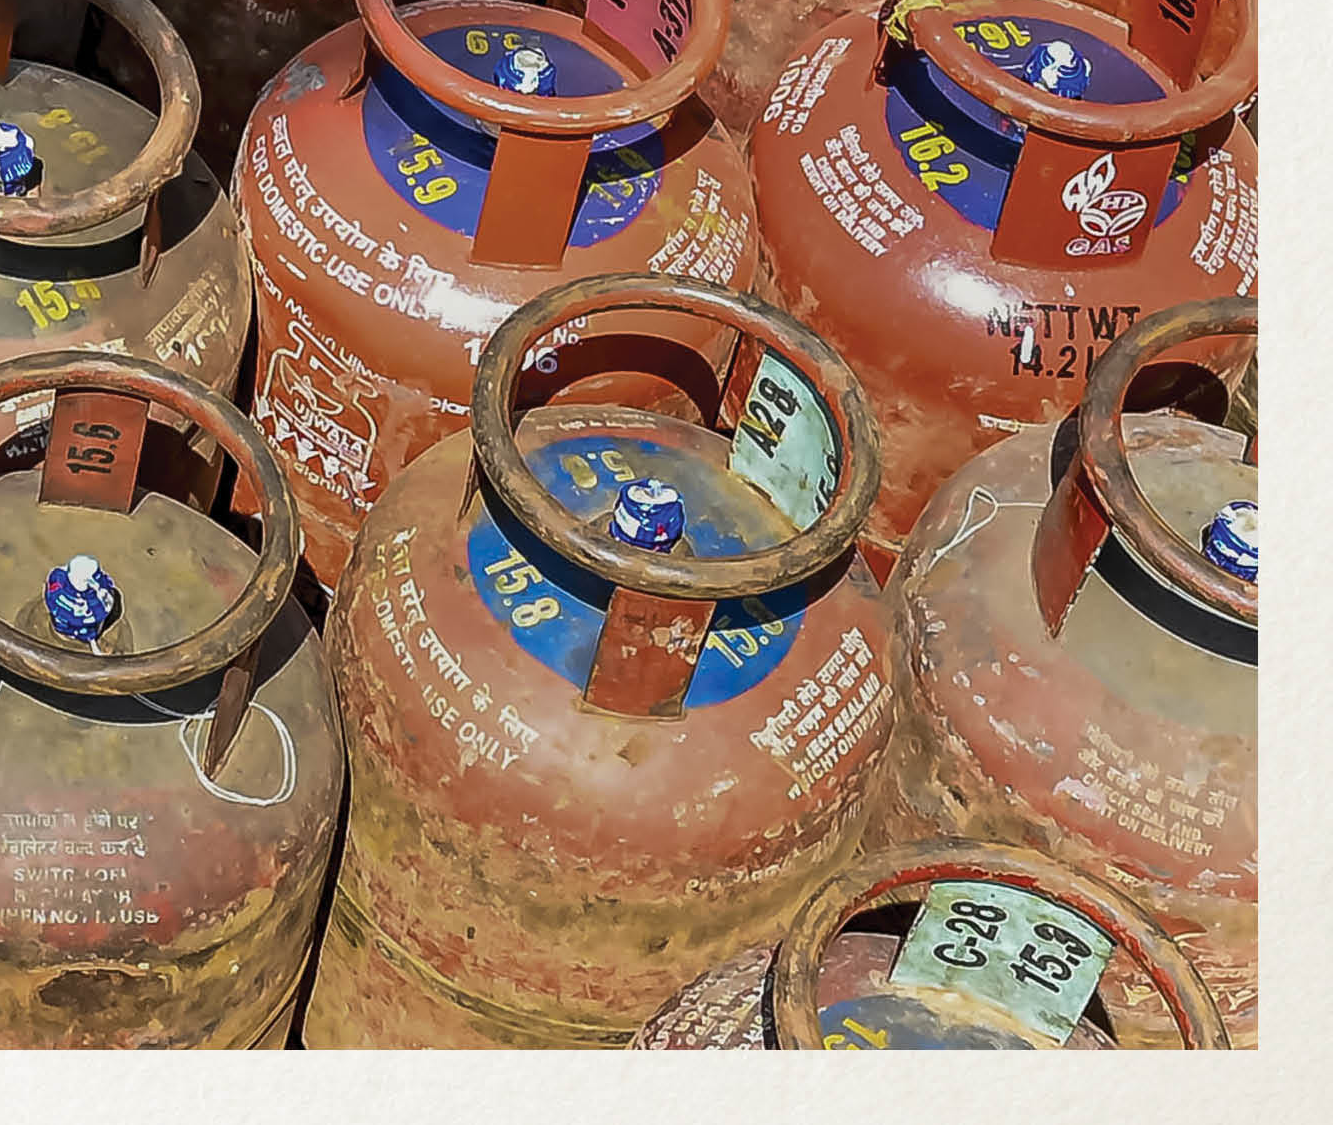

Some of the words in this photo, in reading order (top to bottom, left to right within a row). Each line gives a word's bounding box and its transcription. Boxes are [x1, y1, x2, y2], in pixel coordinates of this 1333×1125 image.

[396, 131, 460, 206] 15.9
[899, 120, 971, 193] 16.2
[250, 131, 270, 184] FOR
[260, 174, 329, 266] DOMESTIC
[324, 256, 370, 297] USE
[815, 155, 845, 194] CHECK
[859, 216, 887, 241] AND
[1100, 194, 1142, 211] HP
[310, 196, 379, 260] उपयोग
[376, 240, 405, 274] के
[1065, 234, 1132, 257] GAS
[1087, 305, 1141, 341] WT
[1009, 344, 1079, 379] 14.2
[65, 421, 123, 476] 15.6
[293, 460, 351, 501] dignity
[483, 545, 562, 629] 15.8
[418, 627, 473, 692] उपयोग
[471, 683, 494, 713] के
[497, 703, 540, 754] लिए
[457, 721, 520, 771] ONLY
[1082, 772, 1131, 811] CHECK
[1131, 802, 1168, 830] SEAL
[1169, 821, 1203, 842] AND
[1117, 813, 1140, 833] ON
[1140, 826, 1215, 858] DELIVERY
[12, 866, 90, 883] SWITC
[933, 897, 1009, 971] C-28
